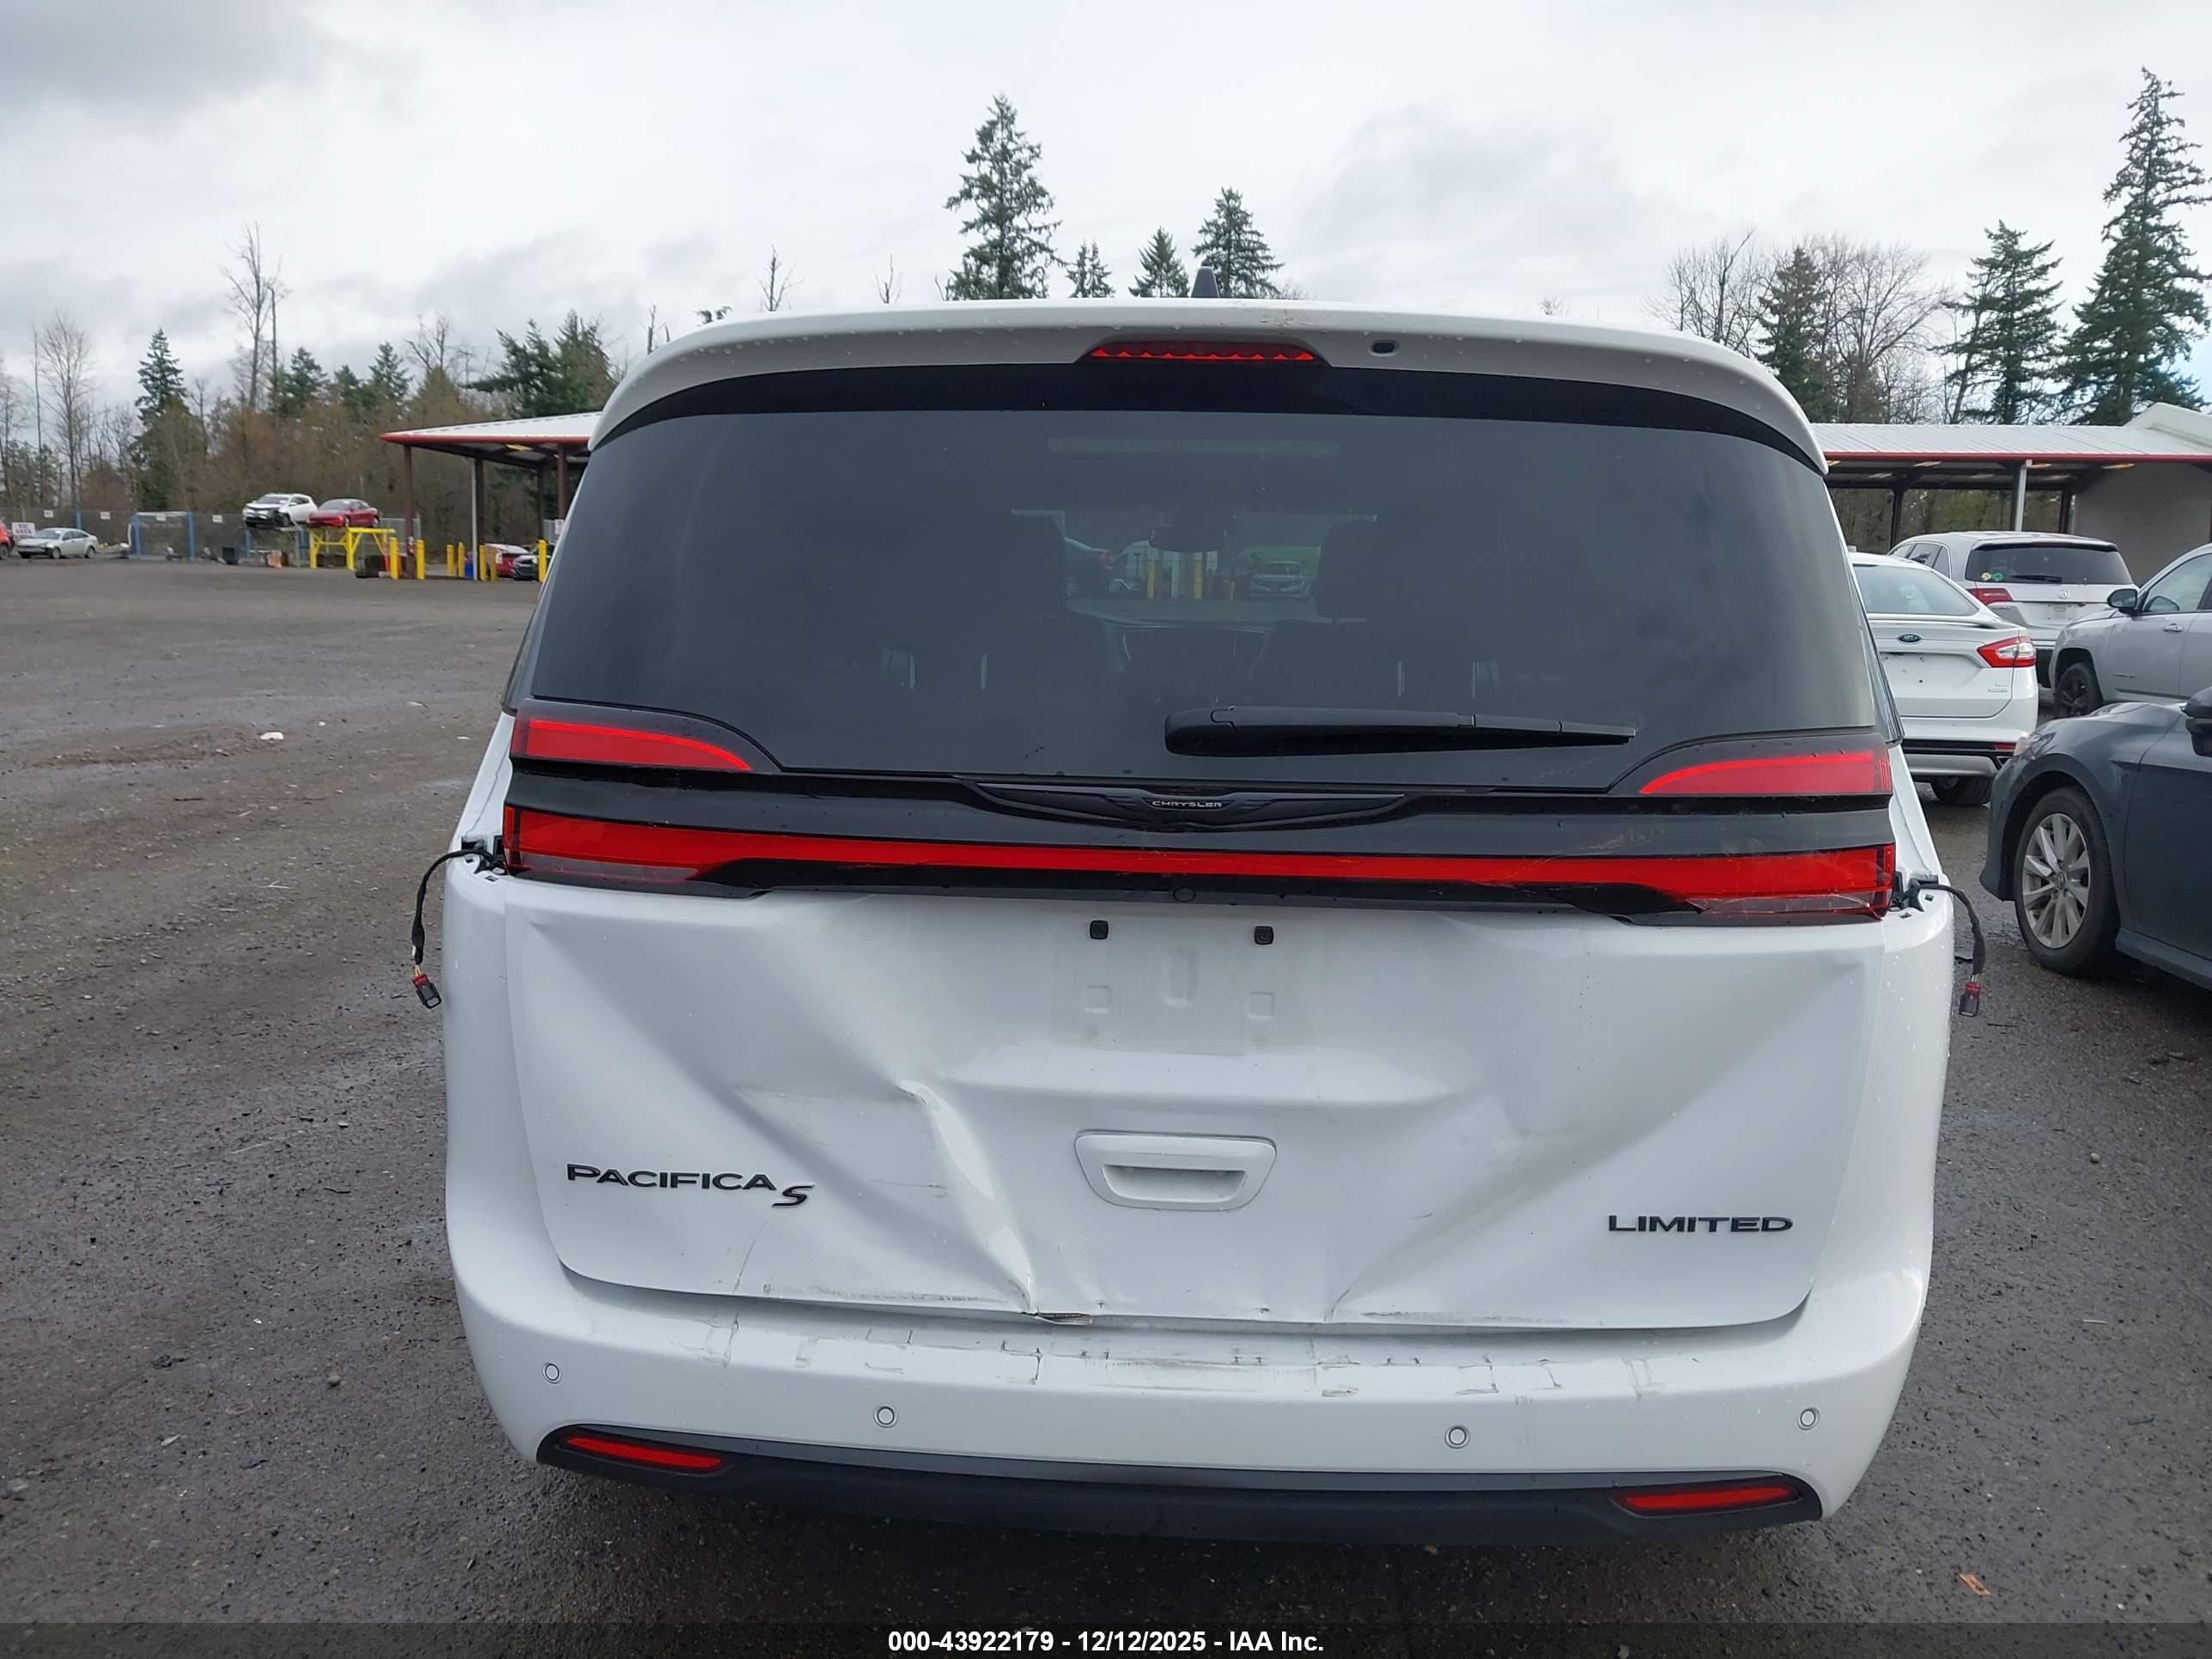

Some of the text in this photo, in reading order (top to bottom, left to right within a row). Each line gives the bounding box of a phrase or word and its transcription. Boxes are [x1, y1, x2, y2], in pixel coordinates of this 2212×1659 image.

[566, 1163, 816, 1208] PACIFICA S
[1608, 1215, 1793, 1232] LIMITED
